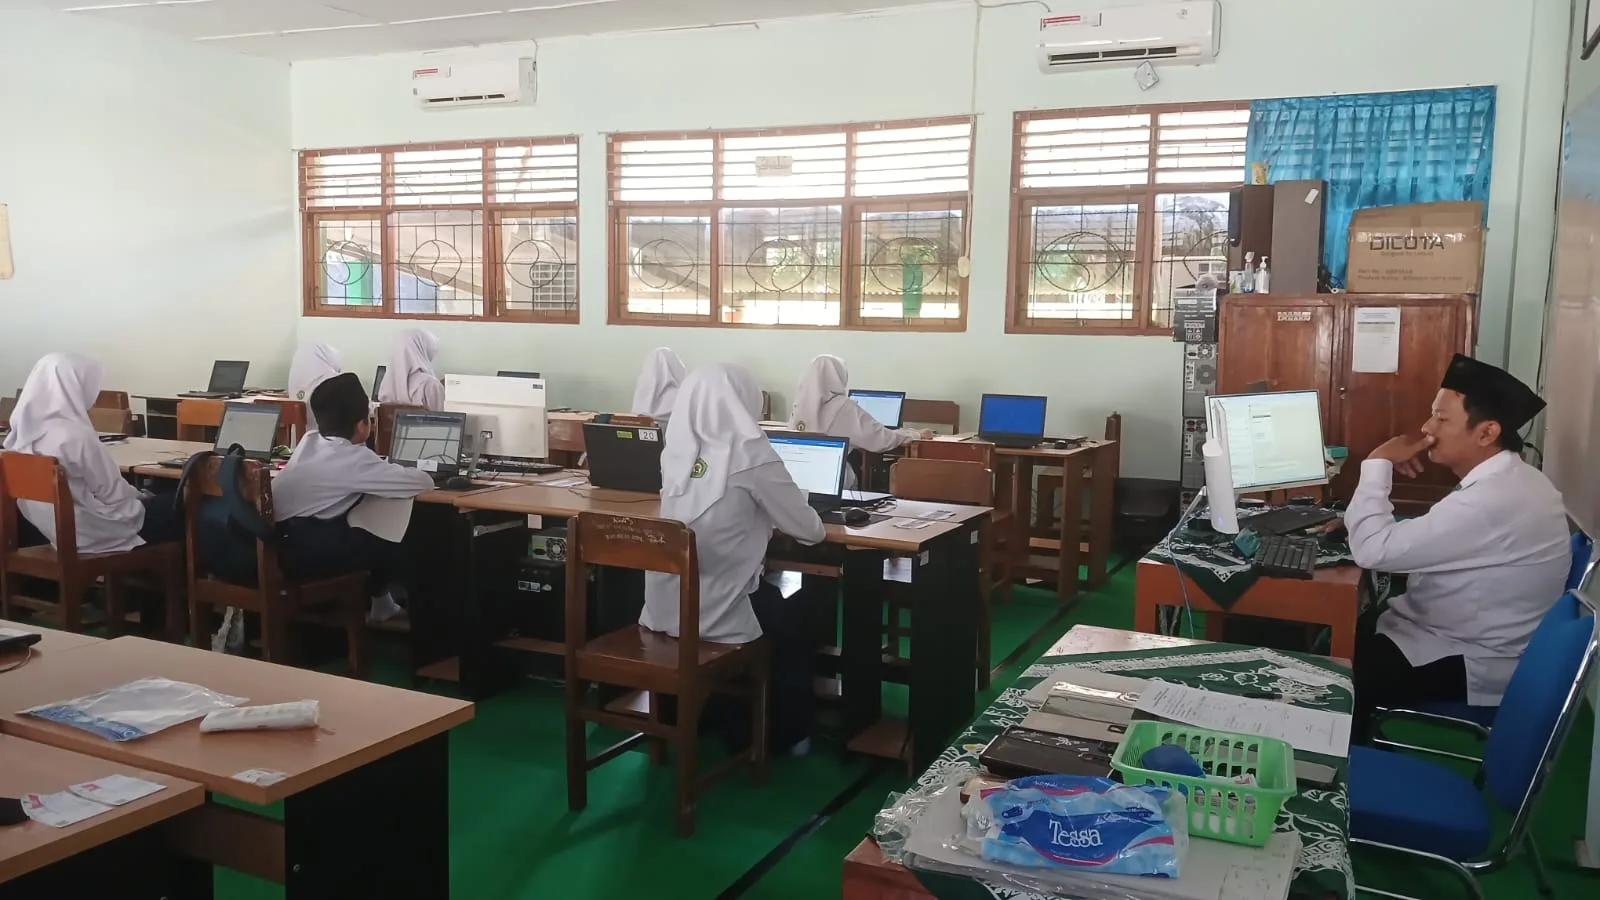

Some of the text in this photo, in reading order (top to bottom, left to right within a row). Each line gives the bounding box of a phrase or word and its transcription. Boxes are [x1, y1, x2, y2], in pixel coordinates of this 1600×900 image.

[1369, 235, 1445, 251] DICOTA
[643, 431, 654, 440] 20
[1049, 818, 1104, 848] Tessa
